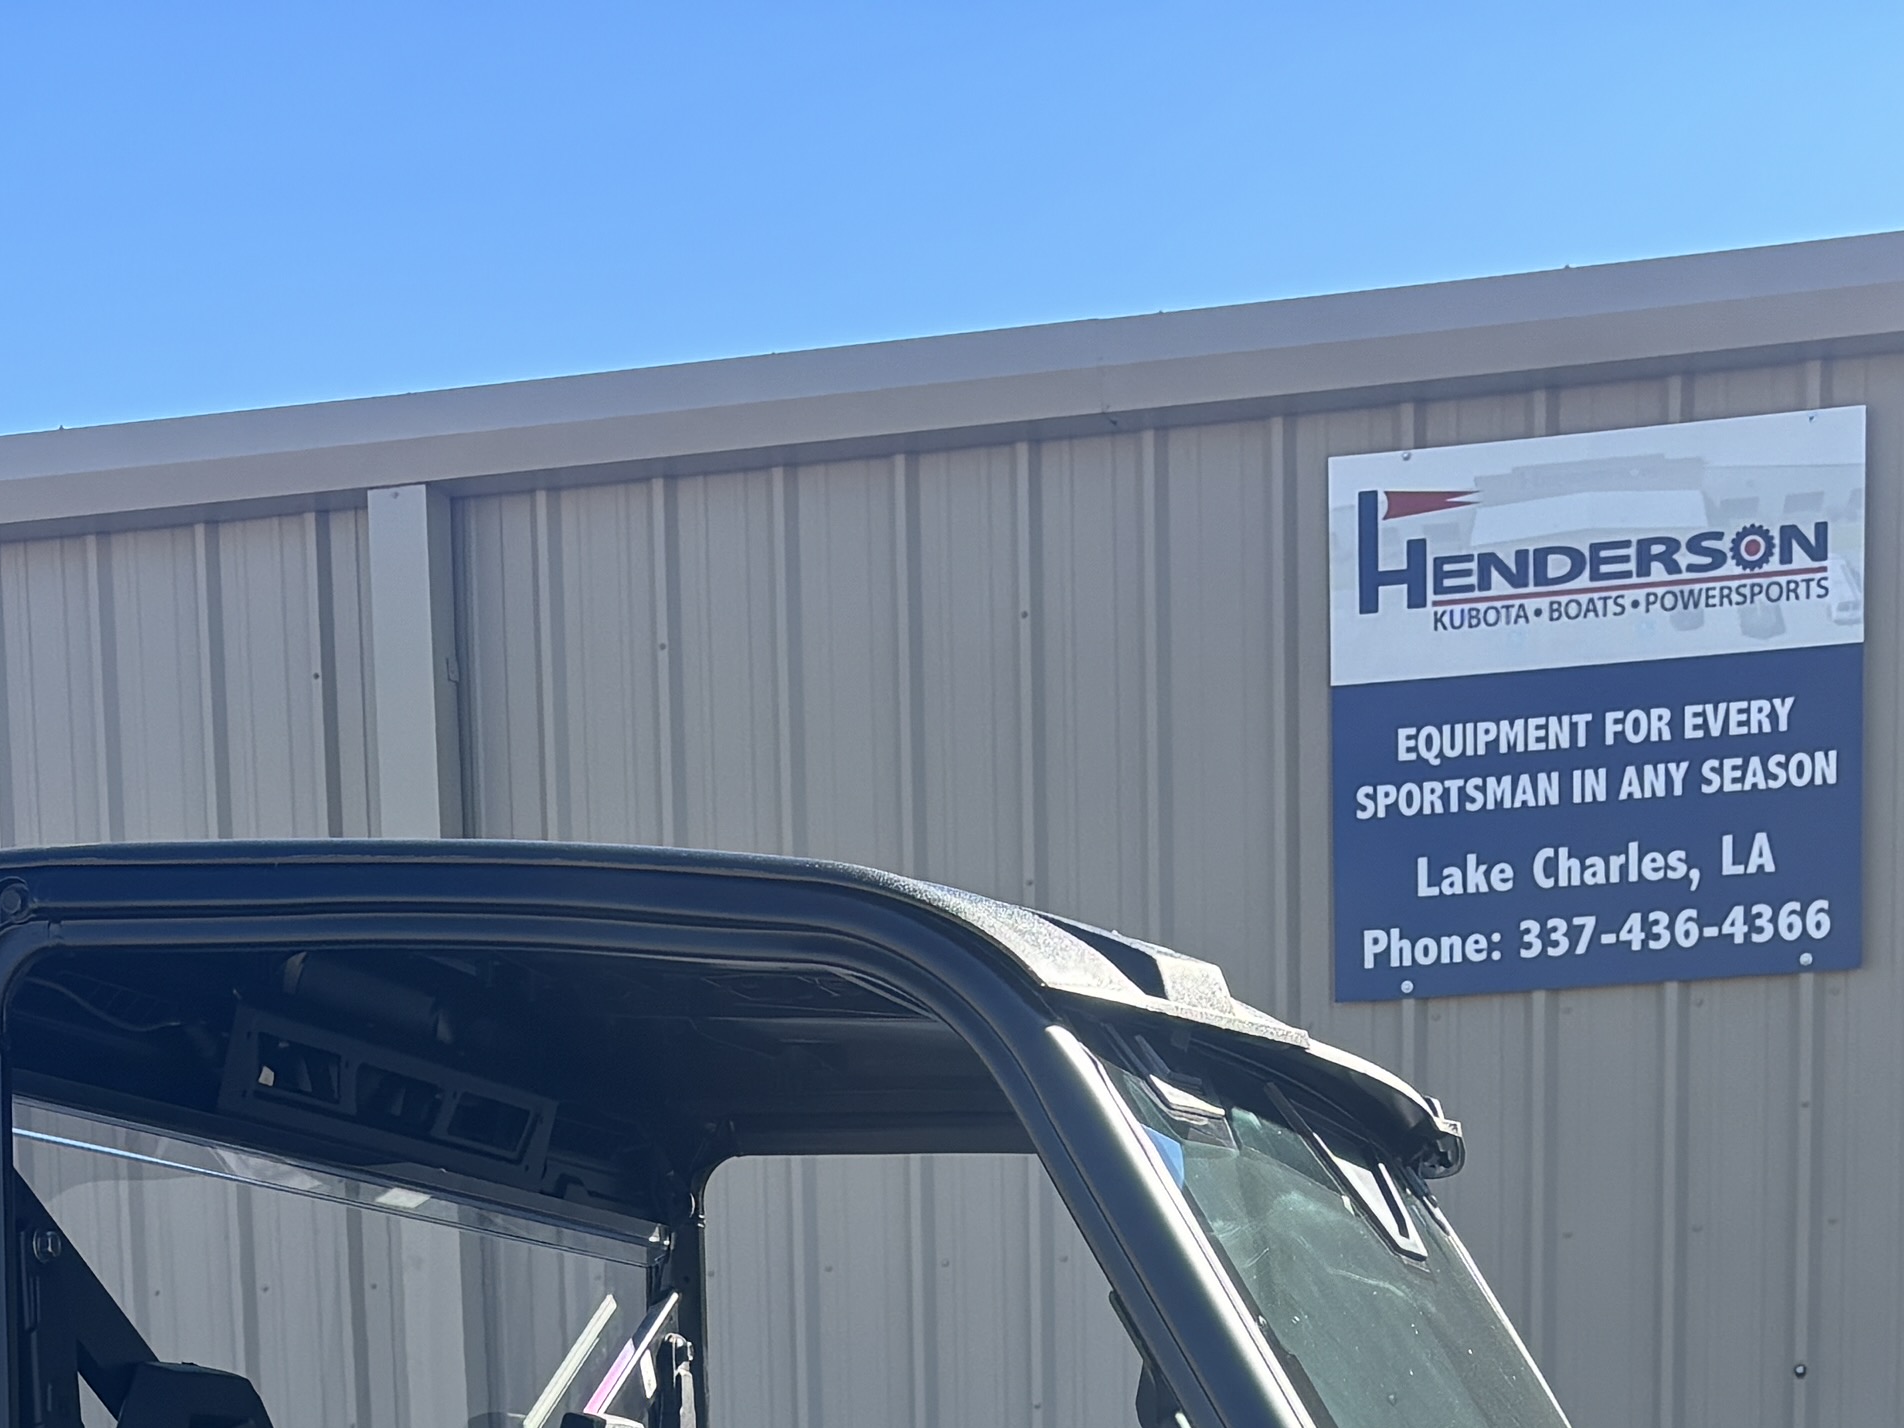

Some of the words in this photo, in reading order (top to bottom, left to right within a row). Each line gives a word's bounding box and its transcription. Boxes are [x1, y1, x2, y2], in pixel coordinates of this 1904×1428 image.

[1357, 489, 1829, 615] HENDERSON
[1432, 604, 1530, 633] KUBOTA
[1548, 596, 1626, 622] BOATS
[1643, 576, 1831, 612] POWERSPORTS
[1396, 712, 1593, 763] EQUIPMENT
[1604, 707, 1672, 746] FOR
[1683, 696, 1795, 740] EVERY
[1355, 771, 1560, 820] SPORTSMAN
[1572, 767, 1608, 803] IN
[1618, 761, 1690, 801] ANY
[1701, 749, 1839, 794] SEASON
[1416, 853, 1515, 897] Lake
[1532, 841, 1702, 892] Charles,
[1721, 832, 1777, 875] LA
[1363, 925, 1503, 970] Phone:
[1518, 899, 1832, 959] 337-436-4366
